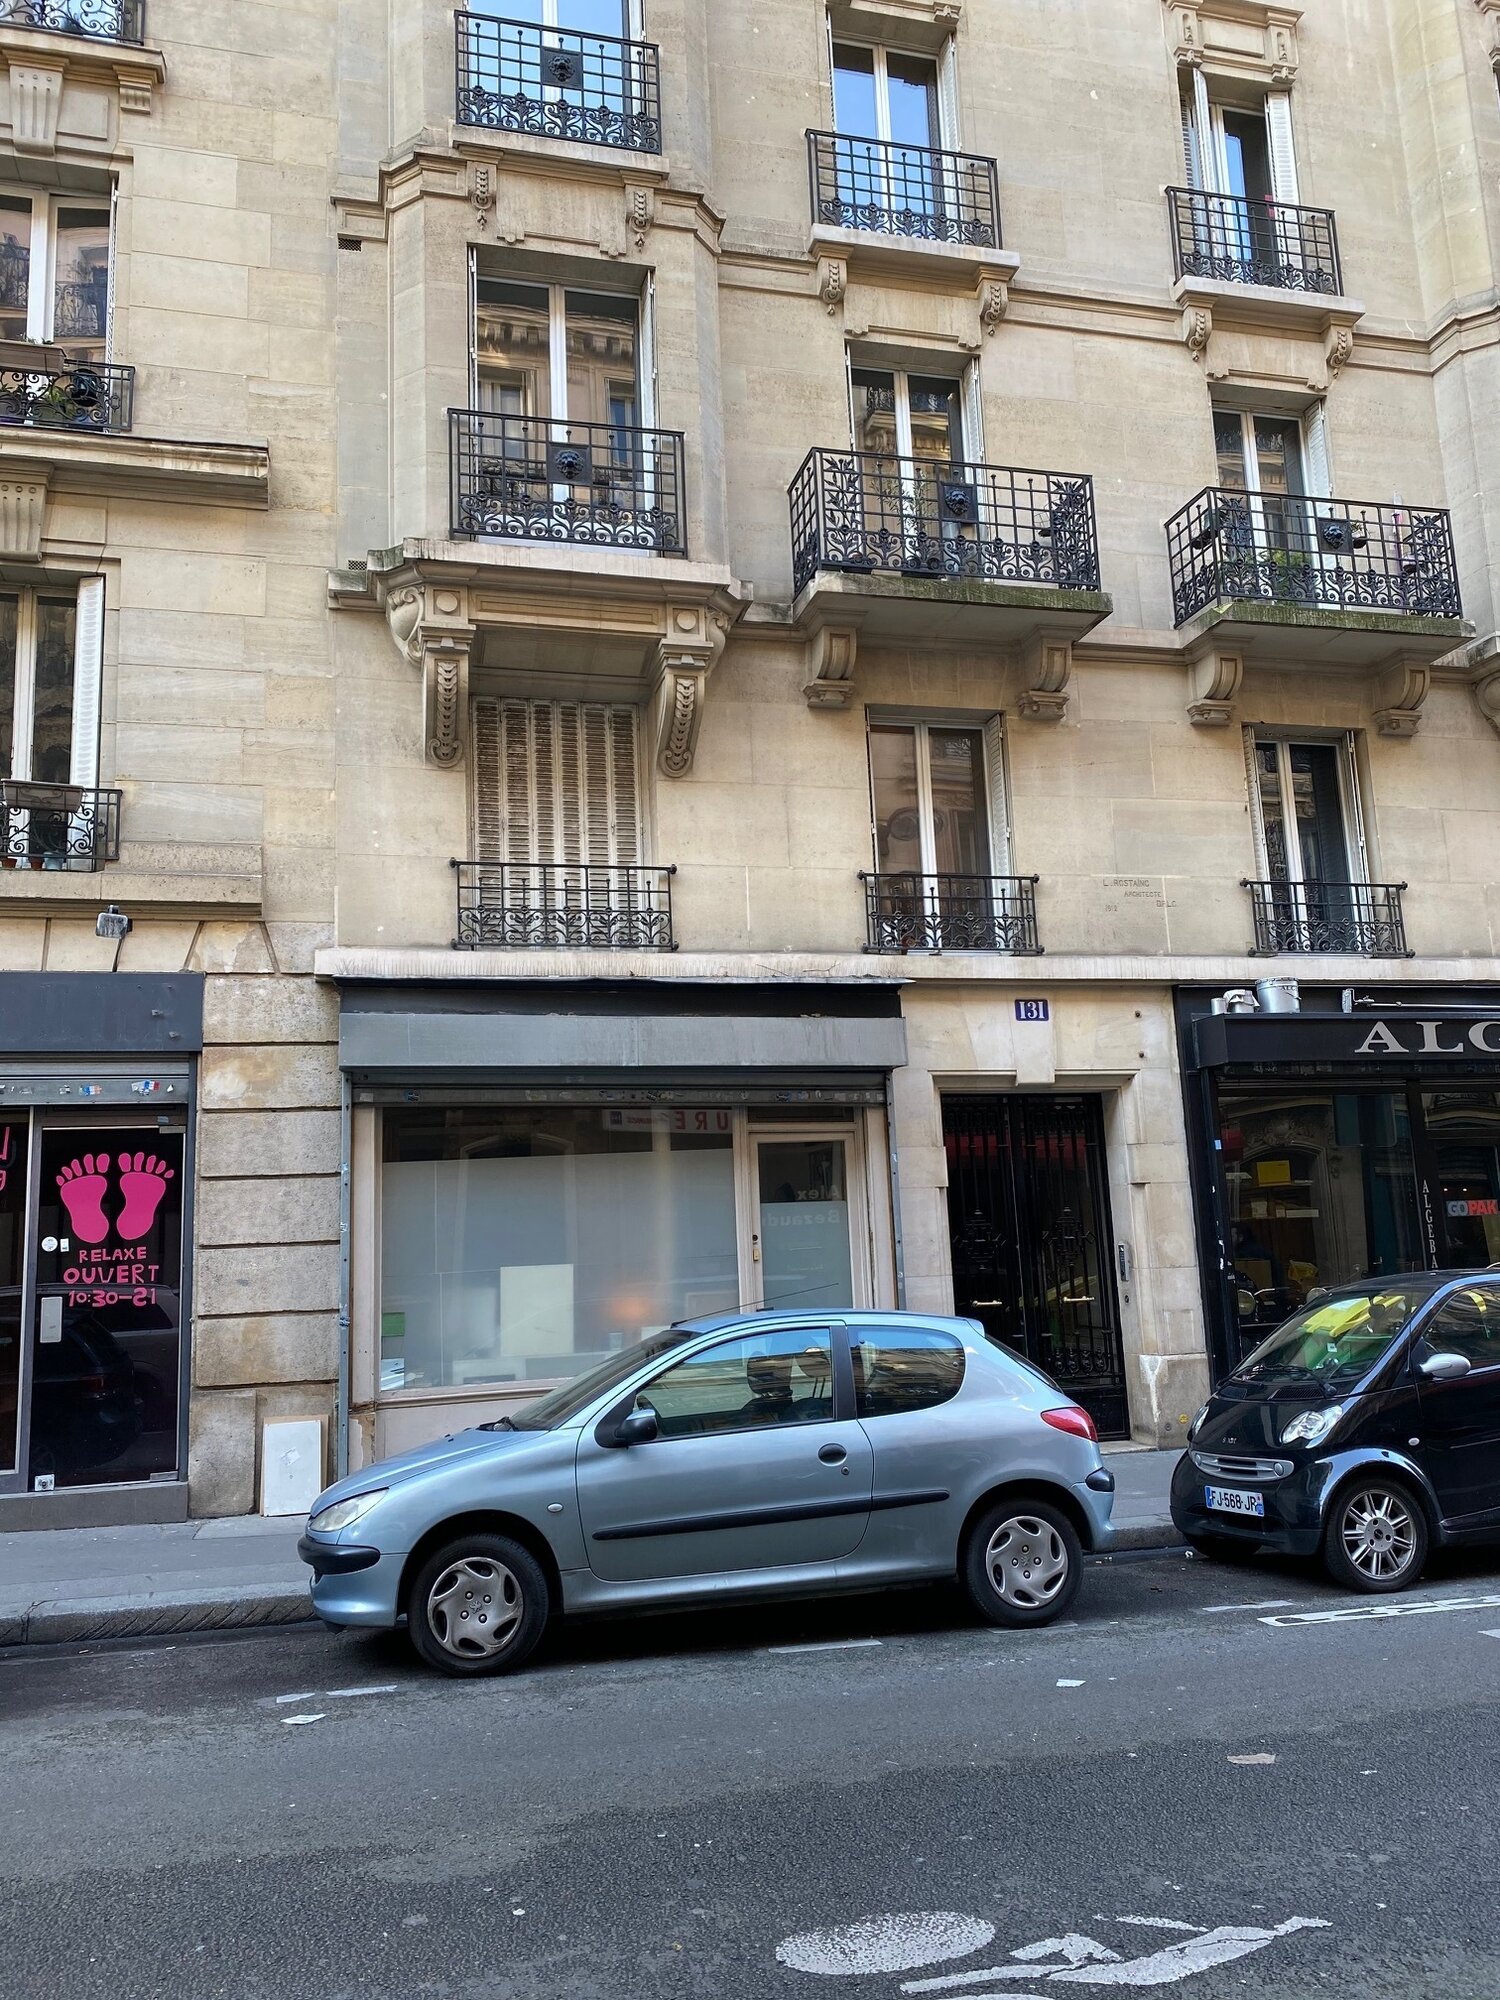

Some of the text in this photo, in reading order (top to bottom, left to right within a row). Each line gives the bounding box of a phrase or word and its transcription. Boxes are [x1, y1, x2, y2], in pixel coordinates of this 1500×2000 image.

[1019, 1001, 1045, 1019] 131
[1422, 1179, 1439, 1271] ALGEBA
[79, 1246, 147, 1264] RELAXE
[63, 1263, 159, 1284] OUVERT
